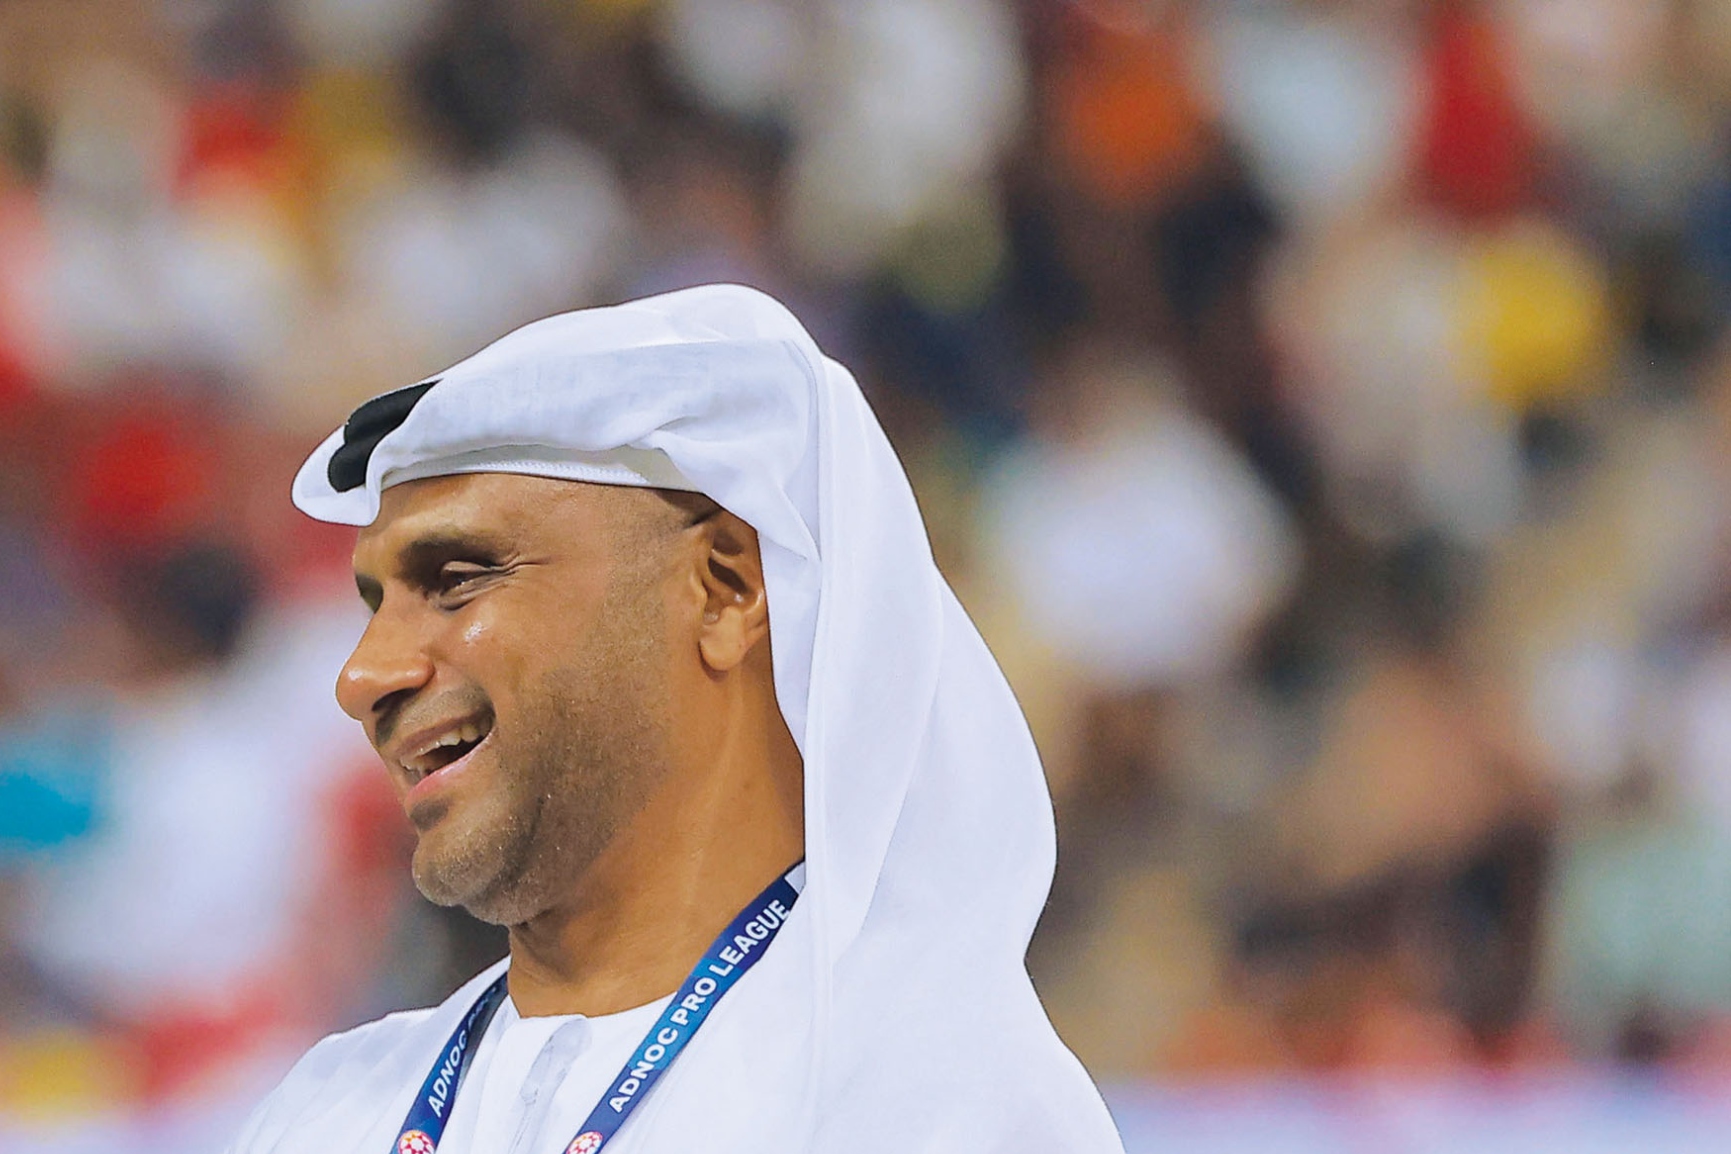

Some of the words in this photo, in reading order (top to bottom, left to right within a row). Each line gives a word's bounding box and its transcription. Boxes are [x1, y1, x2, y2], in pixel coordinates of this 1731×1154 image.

[428, 1030, 466, 1118] ADNOC
[609, 1027, 679, 1113] ADNOC
[670, 977, 717, 1026] PRO
[708, 900, 791, 977] LEAGUE
